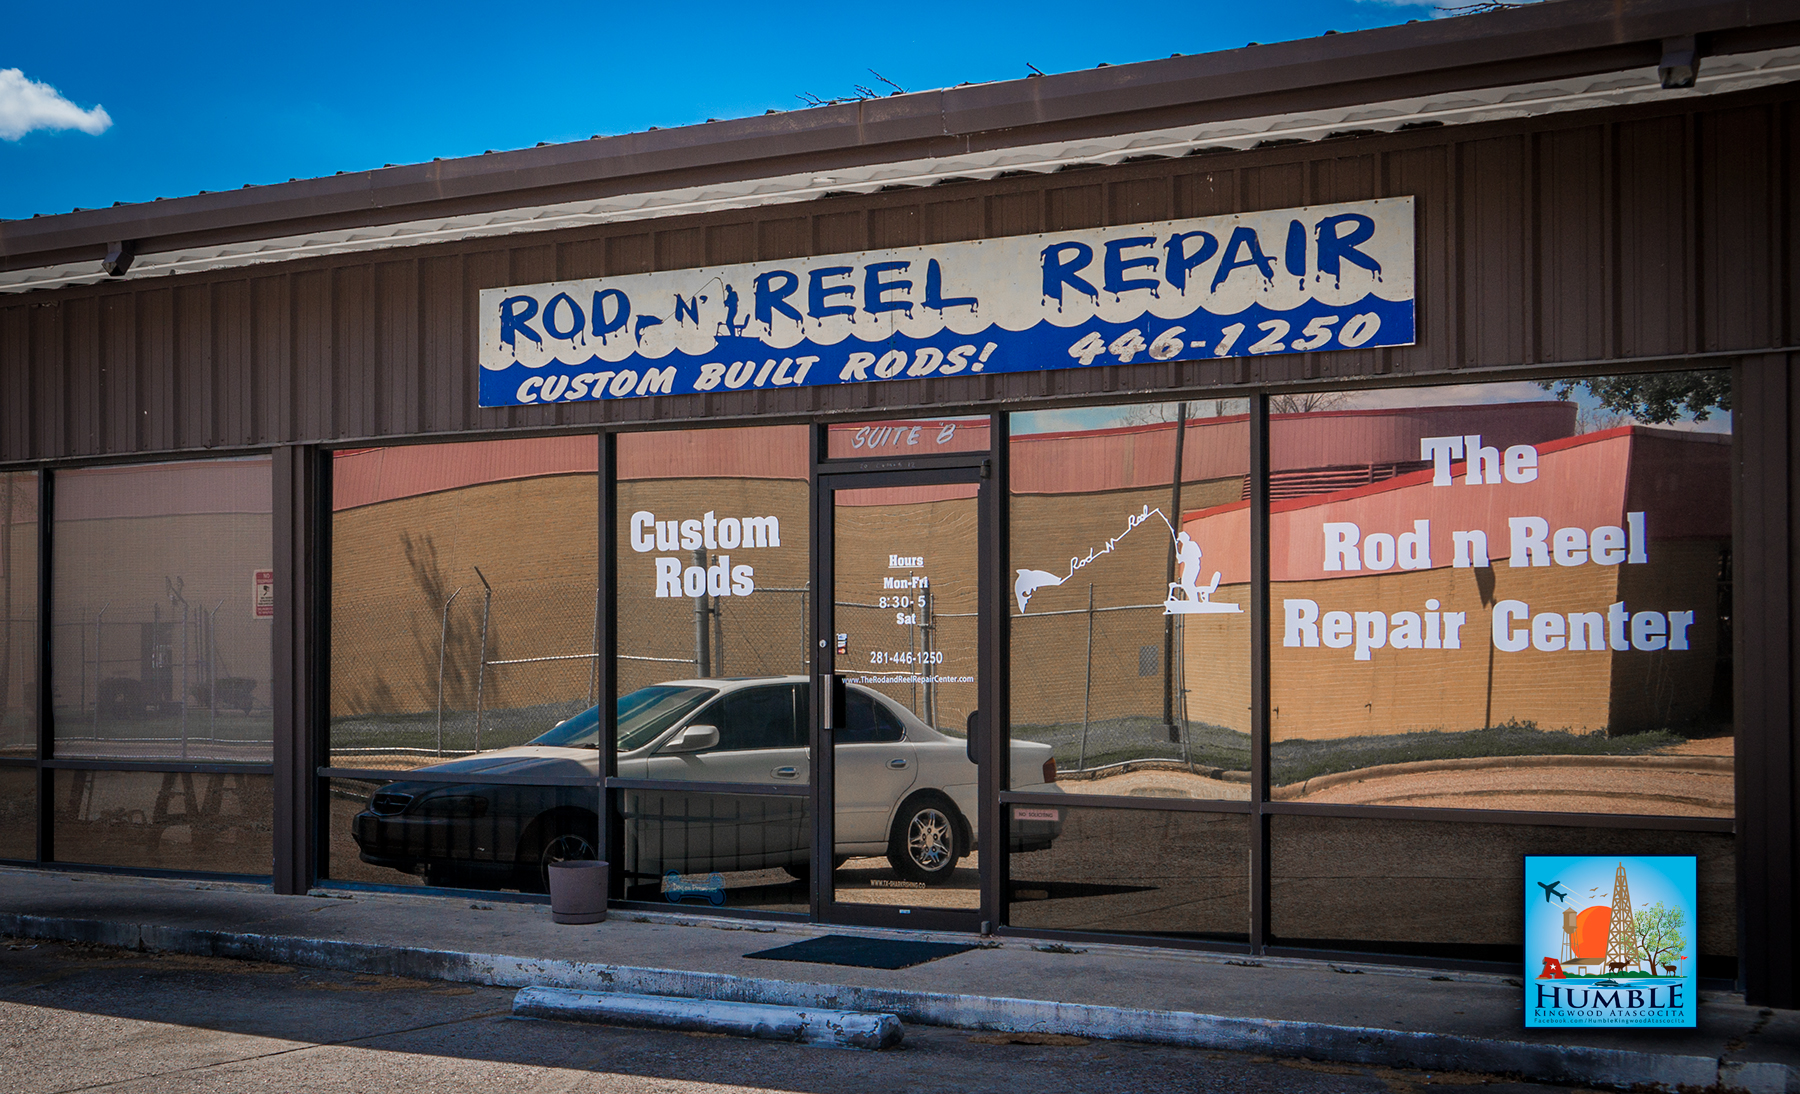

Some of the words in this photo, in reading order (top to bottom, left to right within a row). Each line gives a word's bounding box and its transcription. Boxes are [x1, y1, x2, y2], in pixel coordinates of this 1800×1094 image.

[498, 287, 632, 356] ROD
[752, 257, 979, 336] REEL
[1040, 212, 1382, 313] REPAIR
[515, 365, 677, 404] CUSTOM
[692, 355, 820, 391] BUILT
[839, 341, 998, 382] RODS!
[1067, 311, 1382, 366] 446-1250
[851, 425, 922, 449] SUITE
[1420, 434, 1539, 487] The
[630, 510, 781, 553] Custom
[1322, 519, 1432, 571] Rod
[1452, 529, 1490, 568] n
[1507, 511, 1649, 568] Reel
[888, 555, 924, 568] Hours
[1070, 547, 1095, 571] Rod
[655, 555, 755, 598] Rods
[883, 576, 929, 590] Mon-Fri
[896, 613, 917, 625] Sat
[1282, 598, 1466, 661] Repair
[1491, 599, 1695, 652] Center
[870, 651, 943, 664] 281-446-1250
[841, 675, 974, 685] www.TheRodandReelRepairCenter.com
